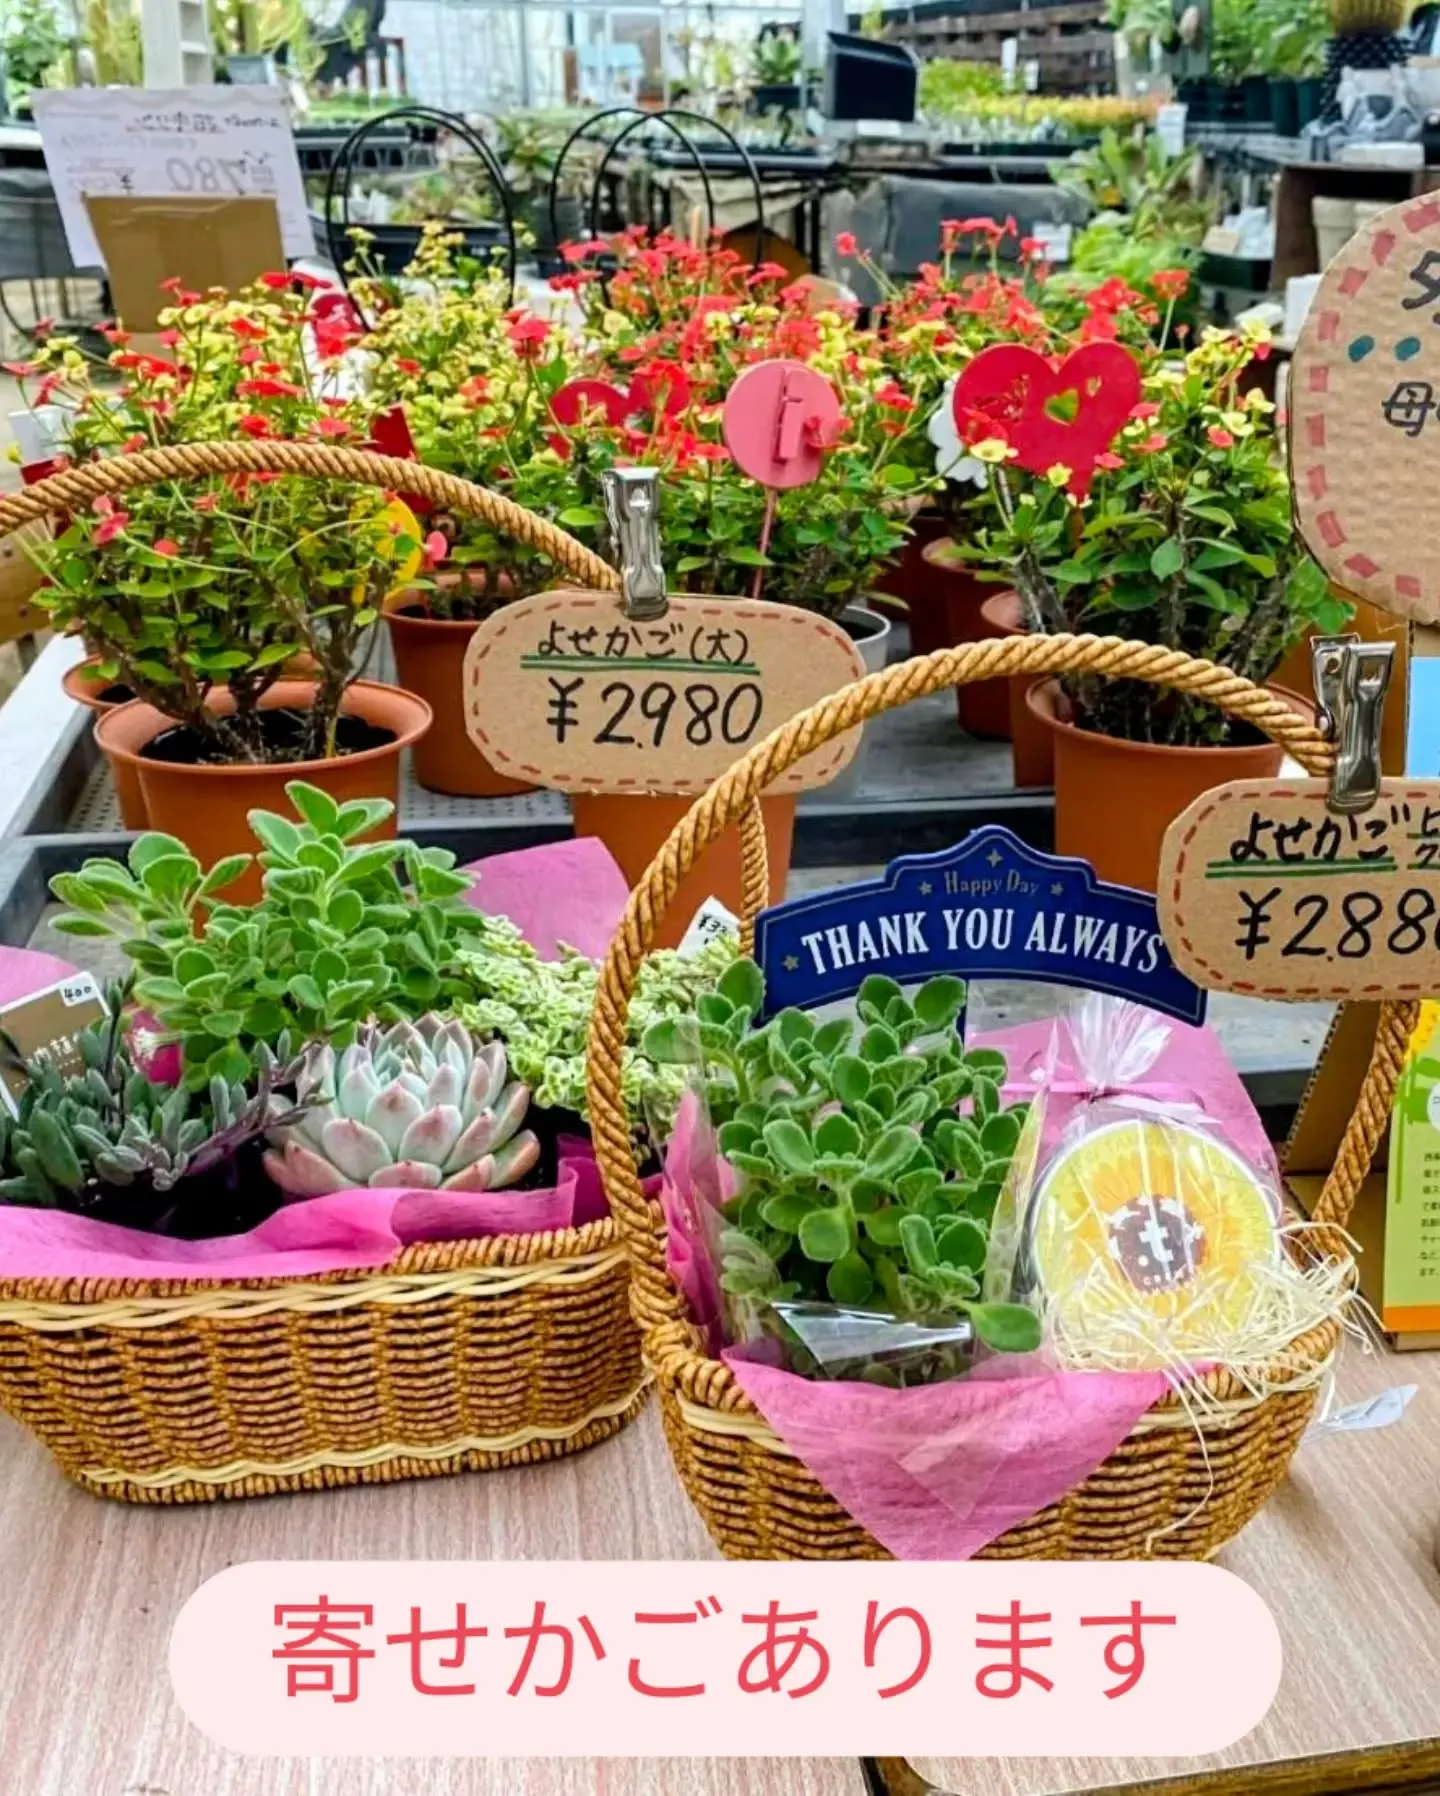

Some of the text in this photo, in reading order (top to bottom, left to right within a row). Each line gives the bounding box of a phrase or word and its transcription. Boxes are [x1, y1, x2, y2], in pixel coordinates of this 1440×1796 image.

[1381, 381, 1440, 437] 母
[943, 869, 1041, 897] Happy Day
[801, 908, 1165, 975] THANK YOU ALWAYS
